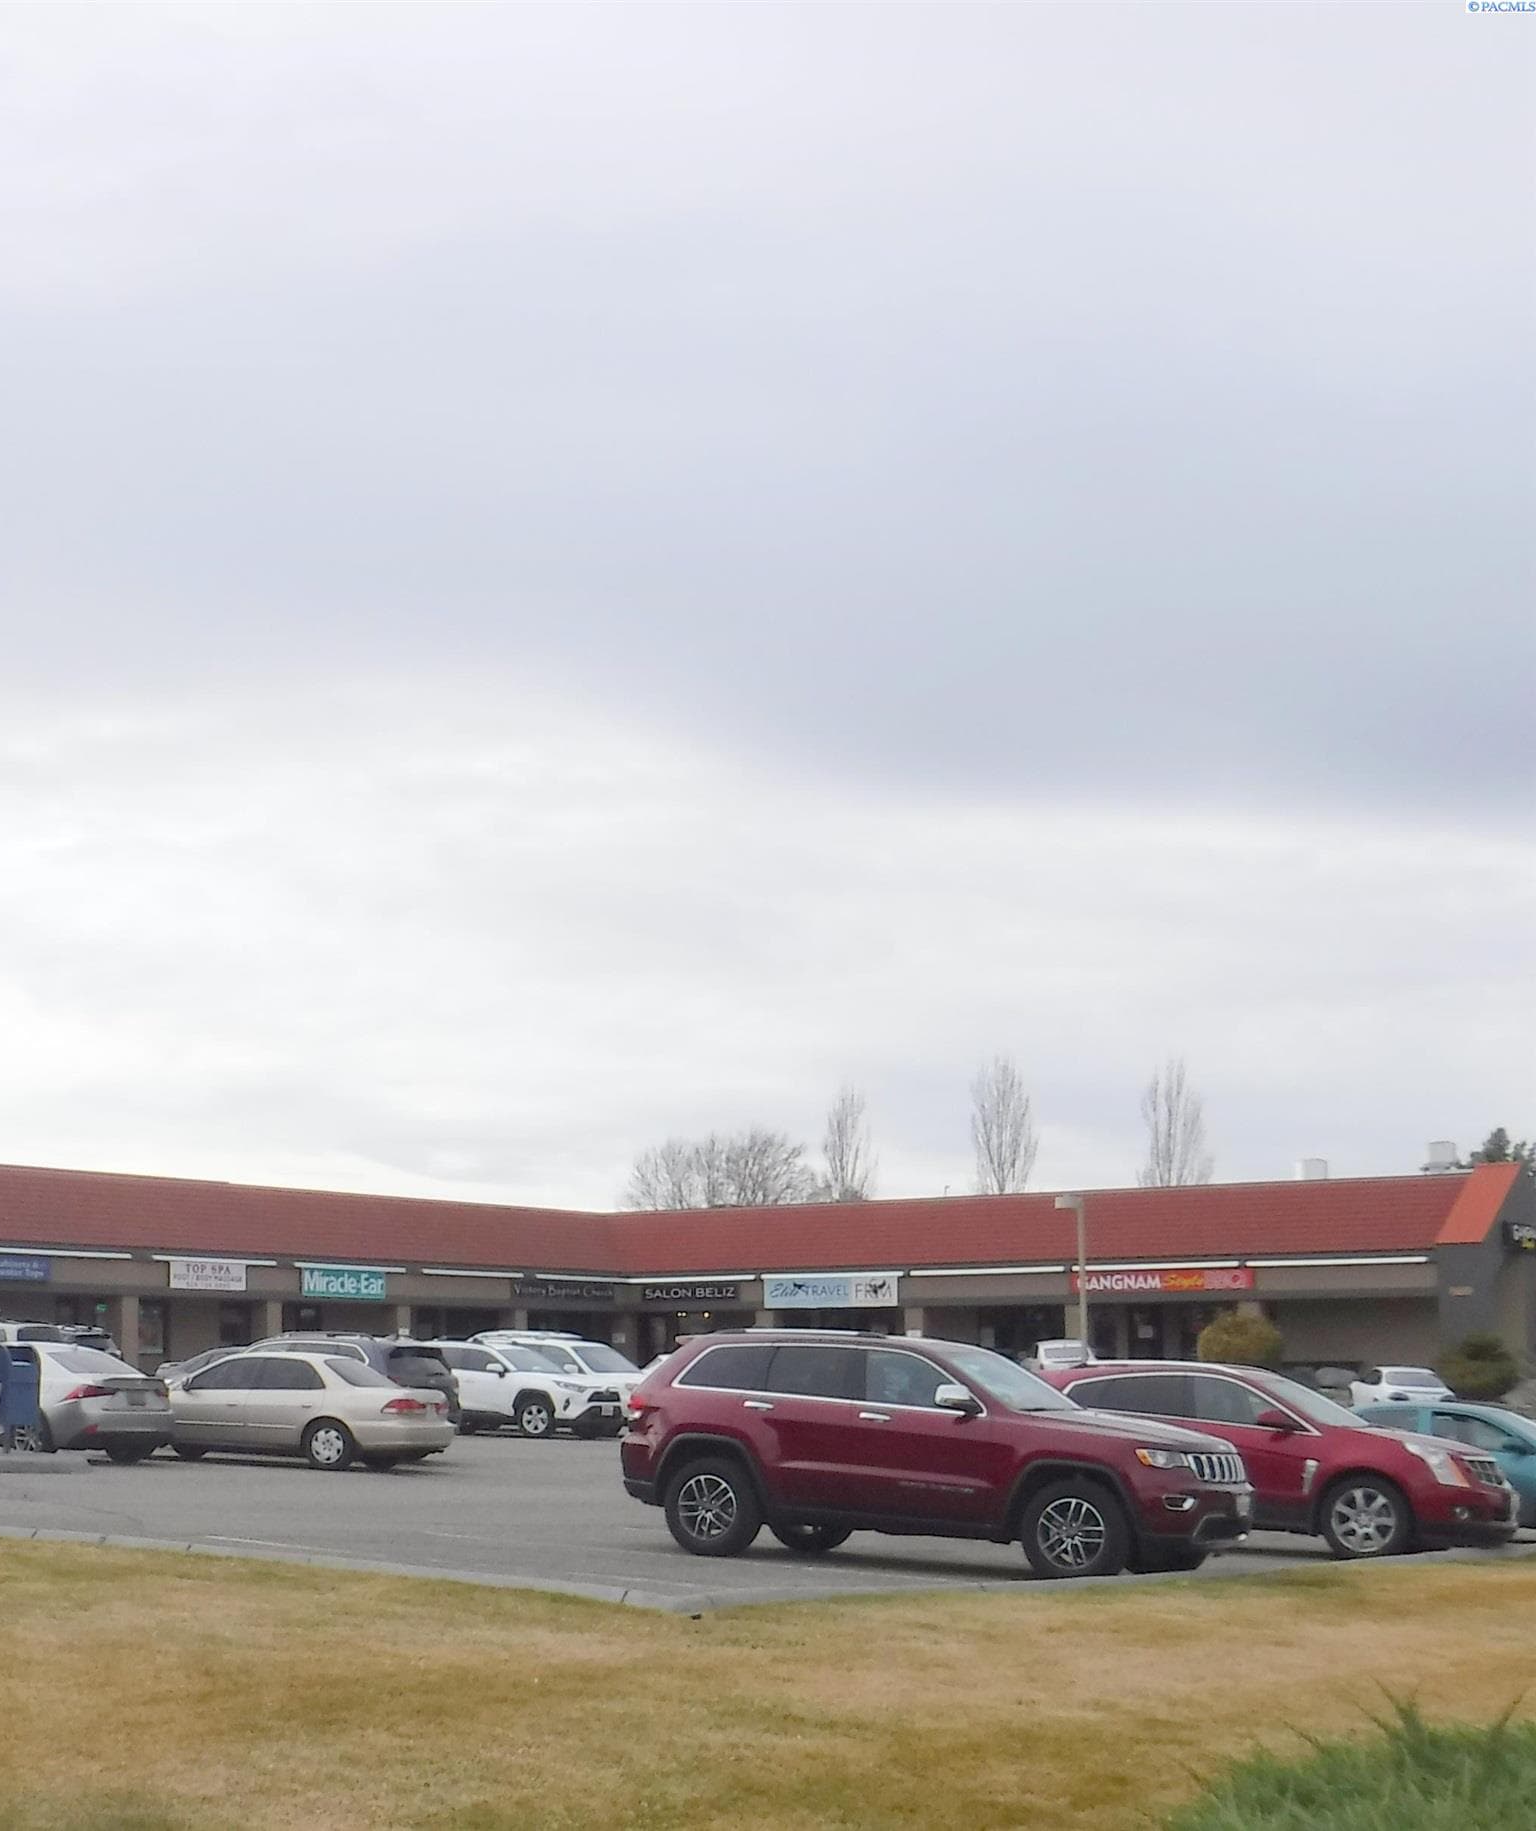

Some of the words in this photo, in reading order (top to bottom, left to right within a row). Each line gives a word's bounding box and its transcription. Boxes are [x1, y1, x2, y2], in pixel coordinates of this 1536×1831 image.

[186, 1263, 207, 1274] TOP
[211, 1265, 231, 1275] SPA
[304, 1269, 384, 1294] Miracle-Ear
[644, 1288, 692, 1299] SALON
[695, 1287, 735, 1298] BELIZ
[802, 1284, 849, 1297] TRAVEL
